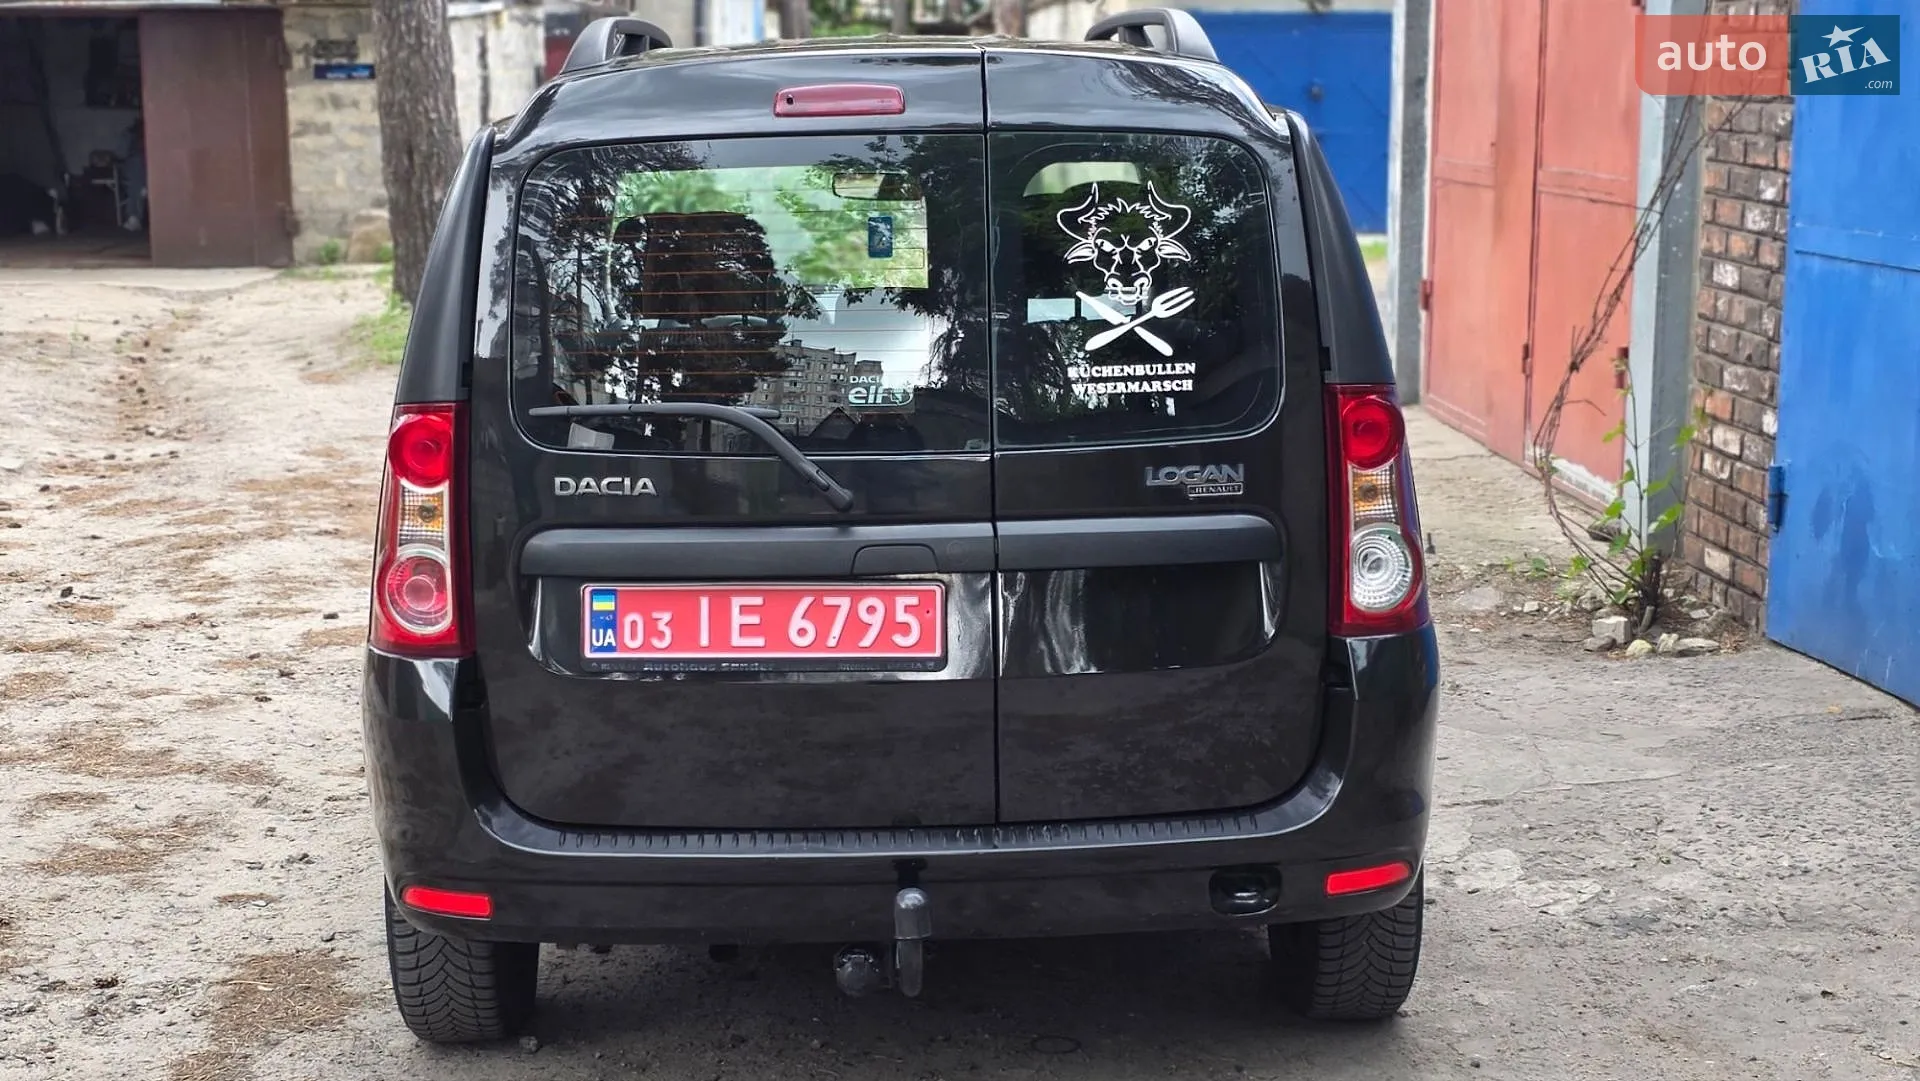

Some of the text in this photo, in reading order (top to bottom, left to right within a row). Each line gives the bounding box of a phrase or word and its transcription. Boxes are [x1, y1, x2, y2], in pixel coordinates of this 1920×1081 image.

[849, 375, 882, 384] DACI
[1071, 379, 1194, 396] WESERMARSCH
[1145, 463, 1244, 486] LOGAN
[554, 477, 657, 497] DACIA
[623, 596, 922, 649] 03 IE 6795
[592, 628, 617, 647] UA
